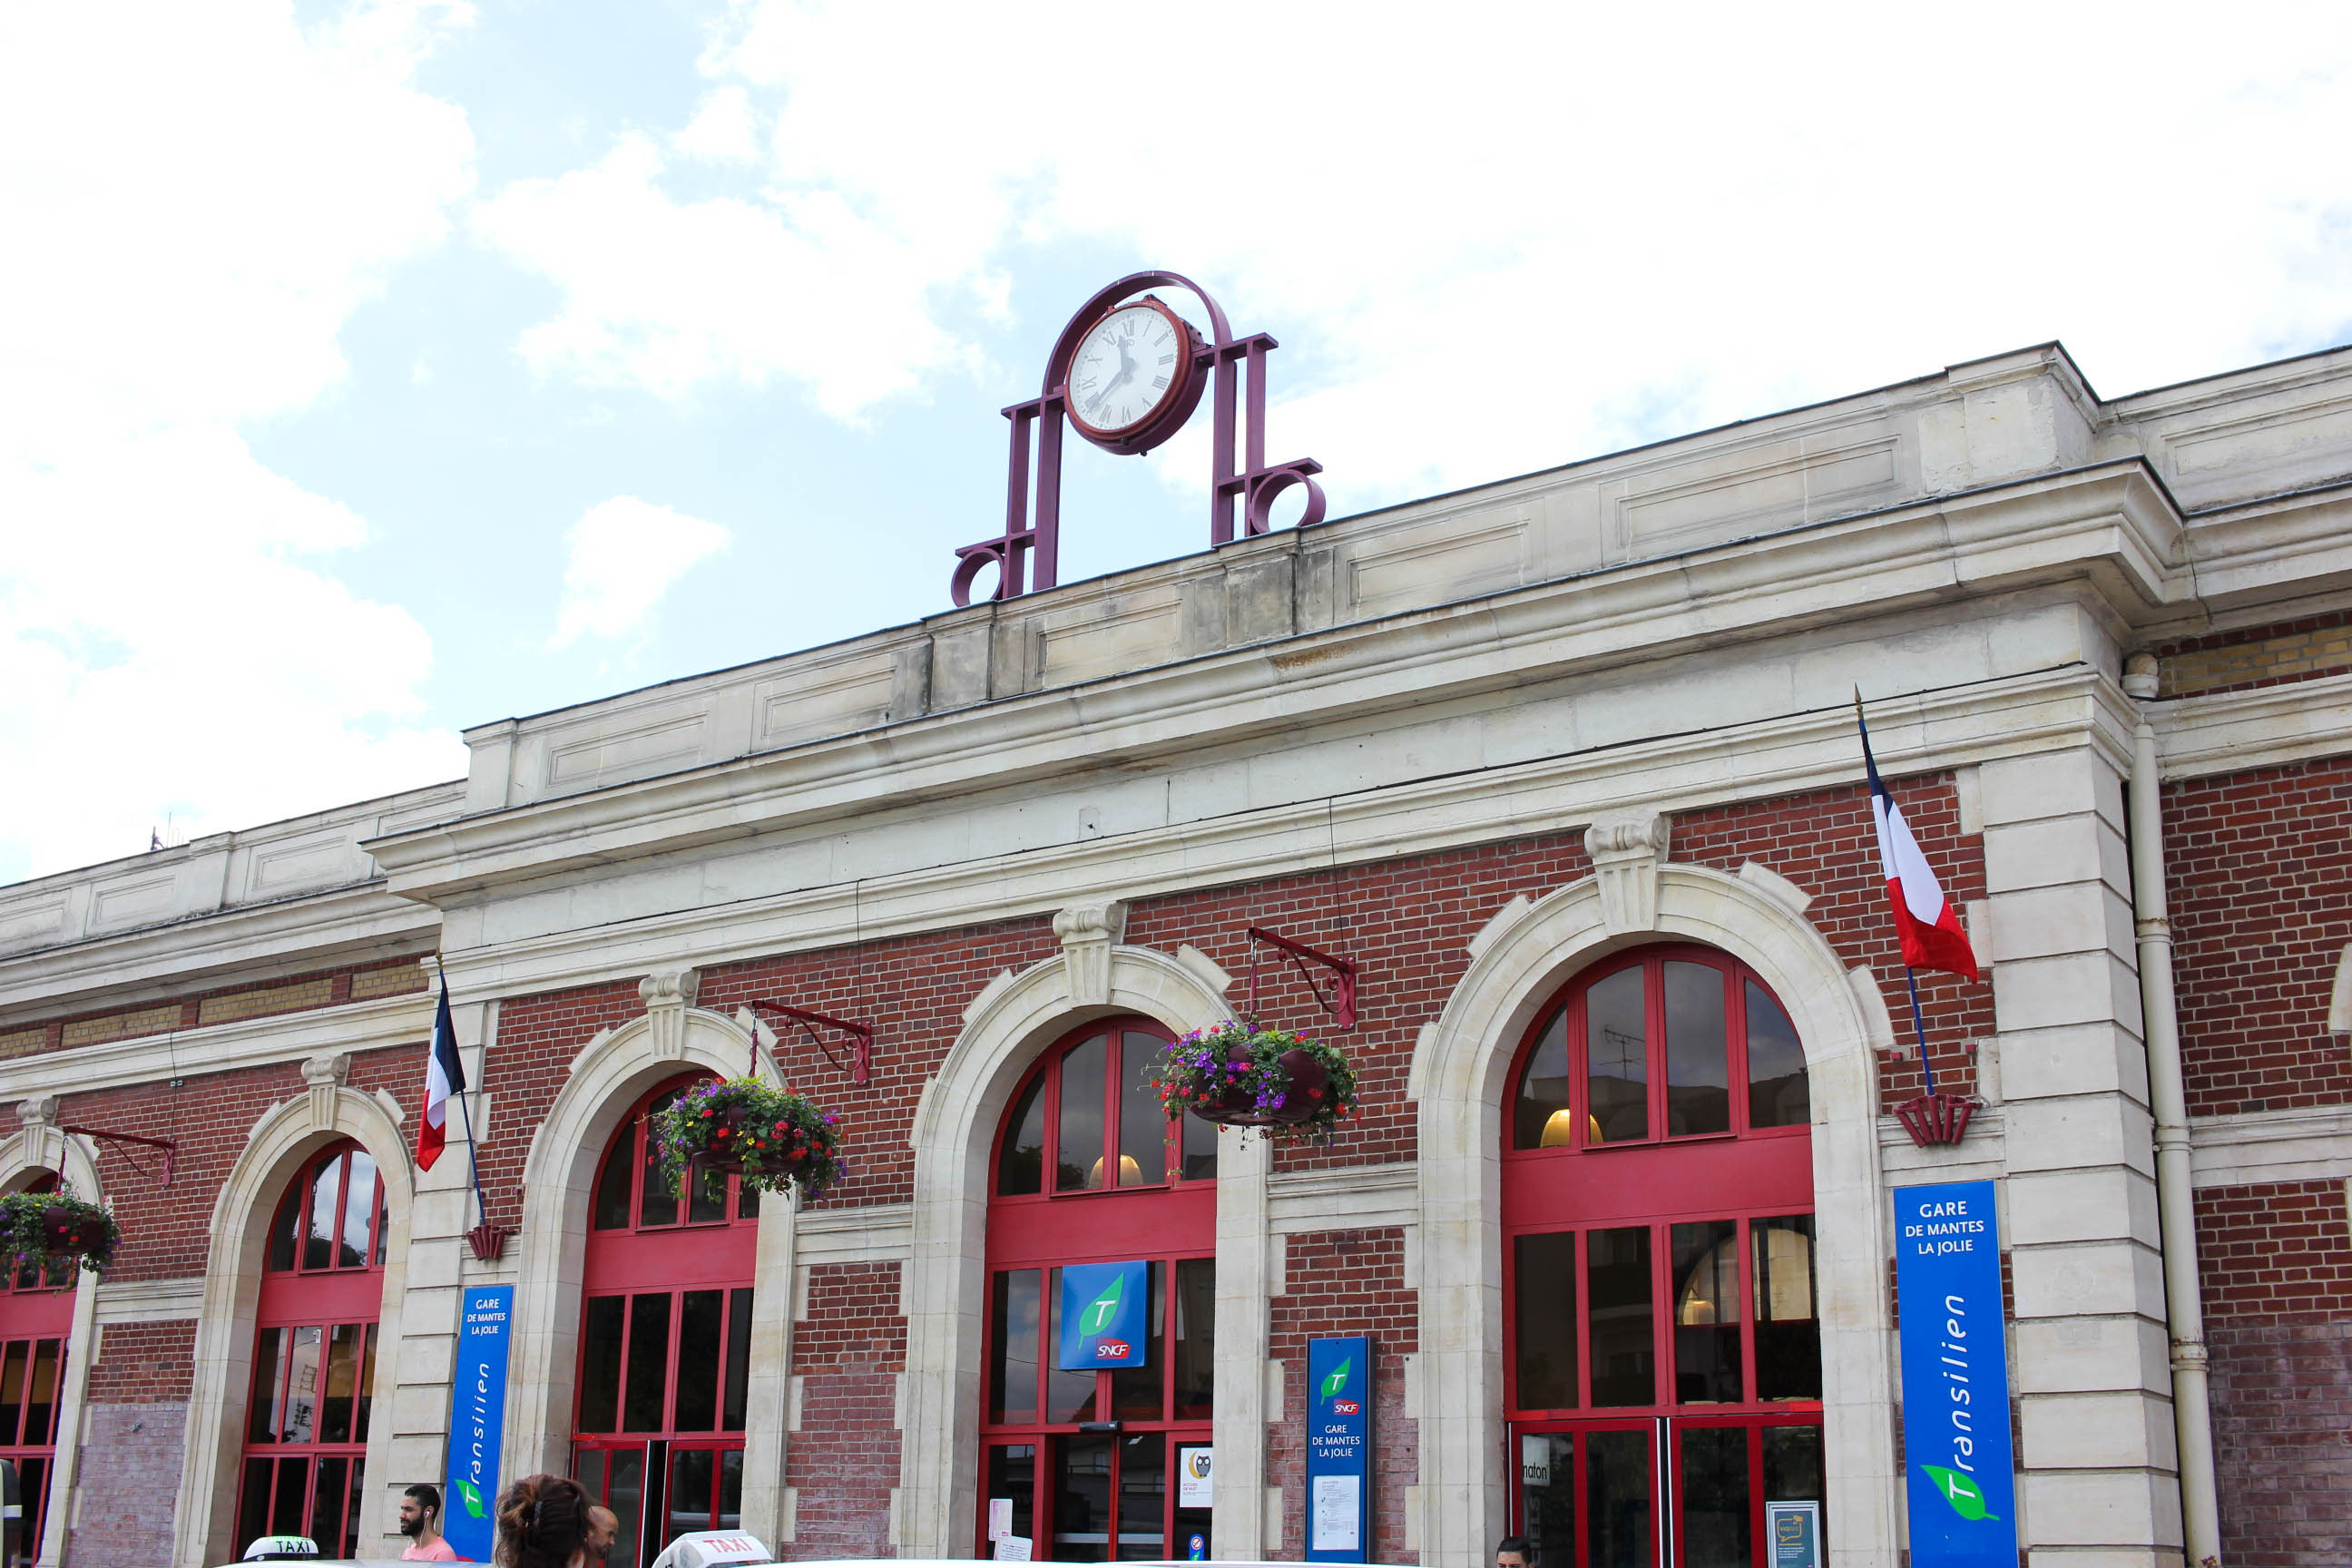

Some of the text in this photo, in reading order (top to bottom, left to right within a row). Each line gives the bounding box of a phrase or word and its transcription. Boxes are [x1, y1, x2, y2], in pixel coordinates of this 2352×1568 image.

[1919, 1200, 1967, 1218] GARE
[1906, 1220, 1984, 1237] DE MANTES
[1918, 1240, 1974, 1256] LA JOLIE
[475, 1298, 499, 1309] GARE
[466, 1312, 505, 1323] DE MANTES
[471, 1325, 499, 1336] LA JOLIE
[1097, 1344, 1129, 1357] SNCF
[1941, 1294, 1976, 1500] Transilien
[1334, 1404, 1358, 1414] SNCF
[466, 1362, 489, 1504] Transilien
[1325, 1425, 1347, 1434] GARE
[1312, 1436, 1360, 1446] DE MANTES
[1318, 1448, 1353, 1459] LA JOLIE
[276, 1541, 310, 1553] TAXI
[702, 1537, 753, 1553] TAXI
